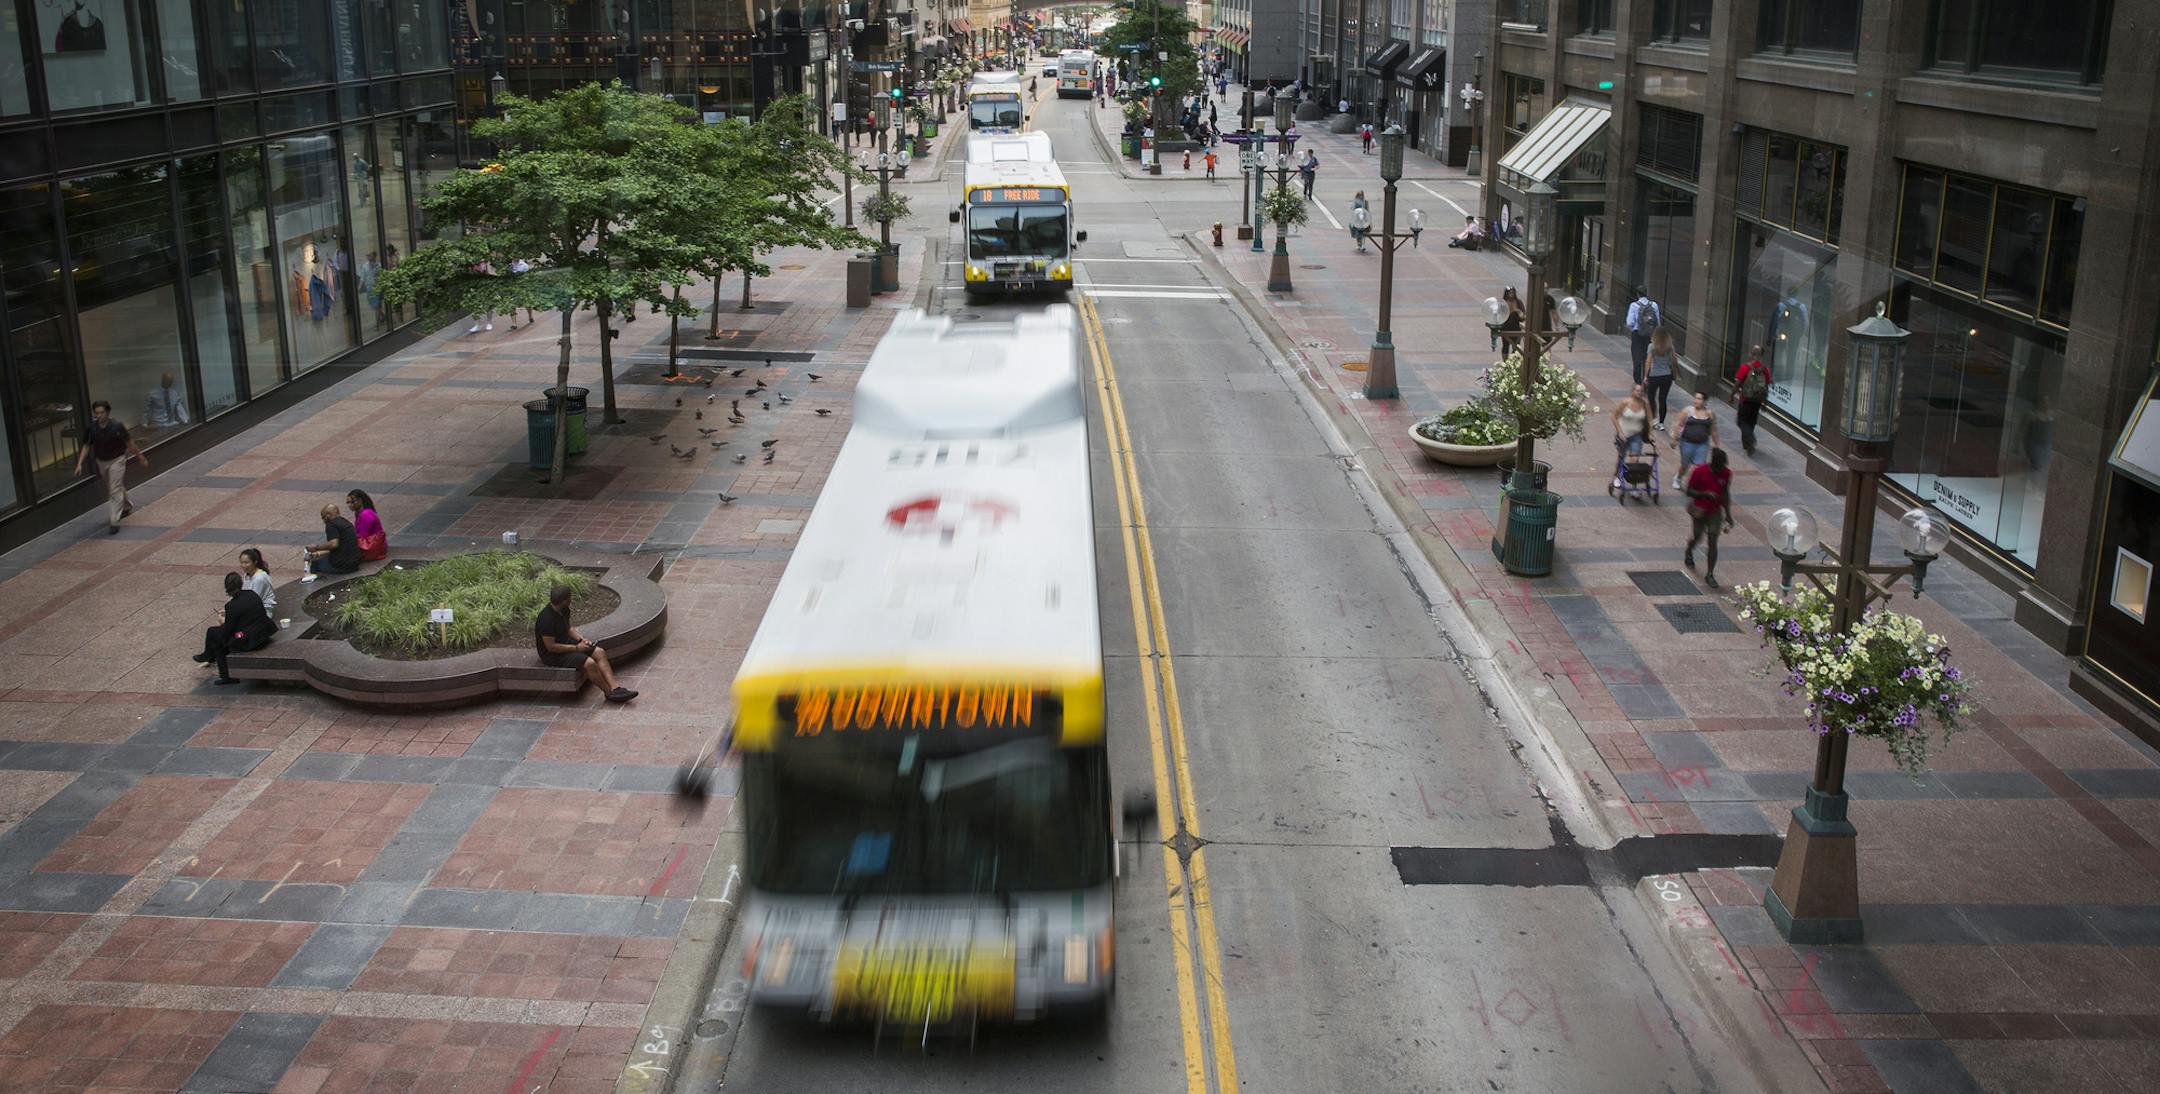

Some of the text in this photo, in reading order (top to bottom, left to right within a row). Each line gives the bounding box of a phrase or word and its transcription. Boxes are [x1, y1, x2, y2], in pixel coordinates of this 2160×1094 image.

[1003, 189, 1021, 201] FREE
[1023, 189, 1040, 200] RIDE
[1934, 480, 1953, 500] DENIM
[1958, 495, 1981, 516] SUPPLY
